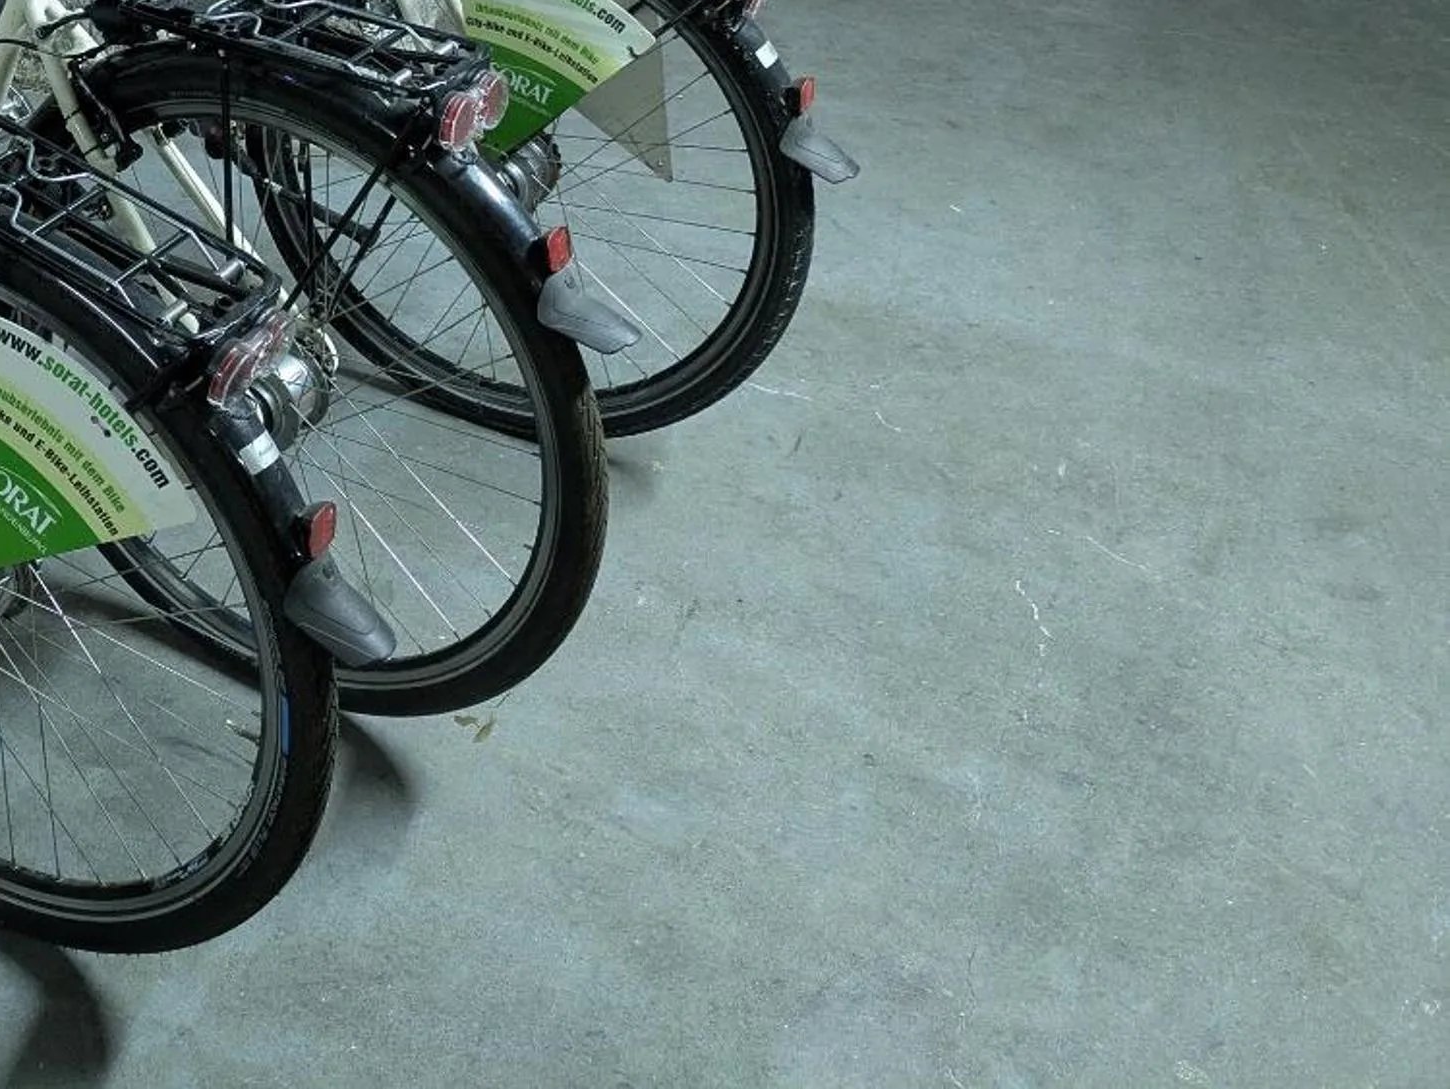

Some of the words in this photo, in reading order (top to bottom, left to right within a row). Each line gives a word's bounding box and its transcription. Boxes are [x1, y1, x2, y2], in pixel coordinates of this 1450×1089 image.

[12, 421, 36, 443] und
[34, 438, 119, 537] E-Bike-Leihstation
[82, 458, 106, 487] dem
[102, 484, 126, 514] Bike
